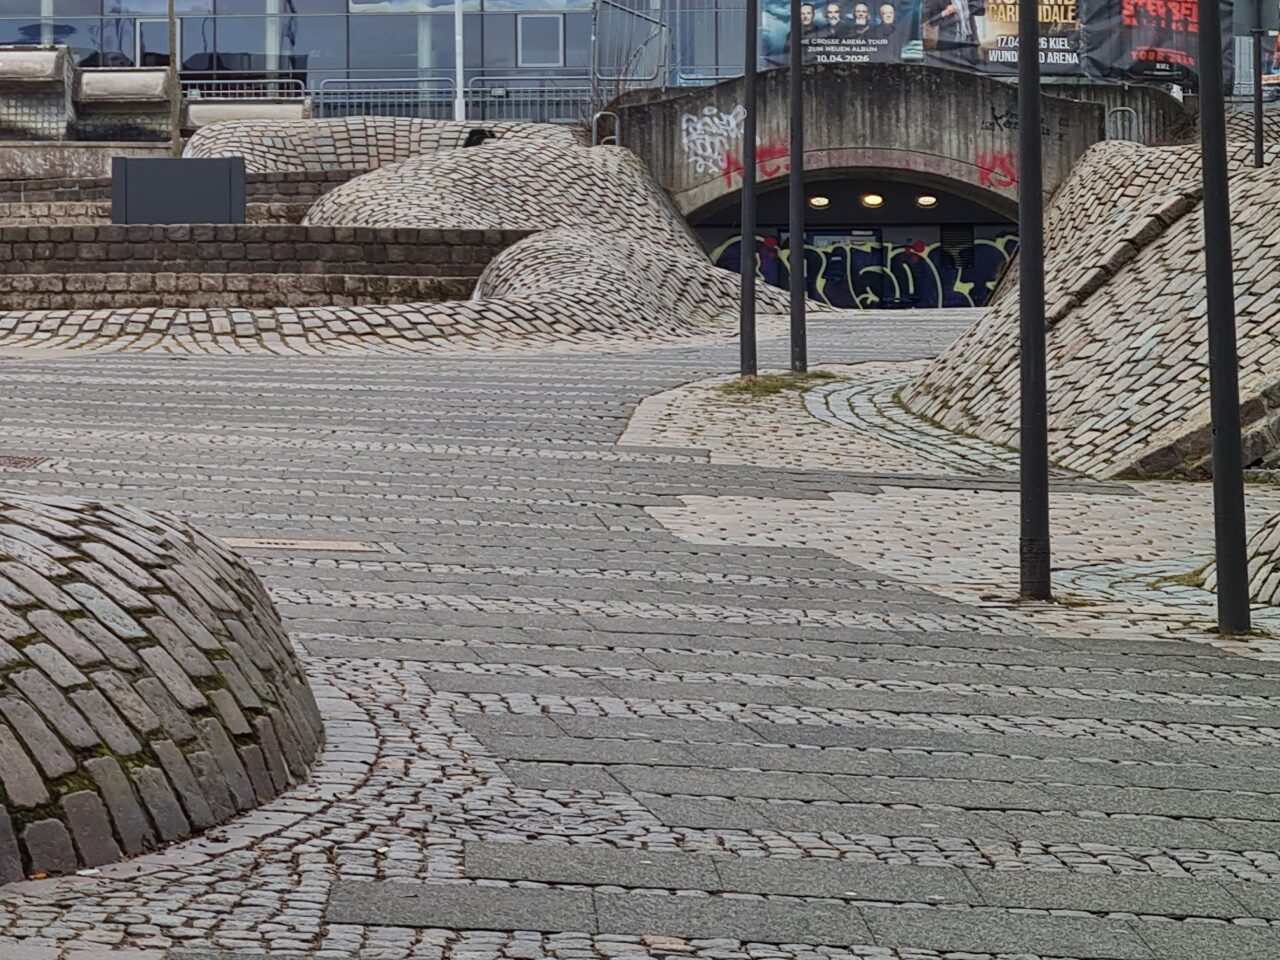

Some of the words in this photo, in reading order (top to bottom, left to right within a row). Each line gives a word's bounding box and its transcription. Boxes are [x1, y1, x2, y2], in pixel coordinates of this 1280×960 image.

[987, 4, 1077, 23] CARDALE
[1048, 37, 1070, 49] KIEL
[816, 54, 870, 62] 10.04.2026
[1046, 51, 1079, 64] ARENA
